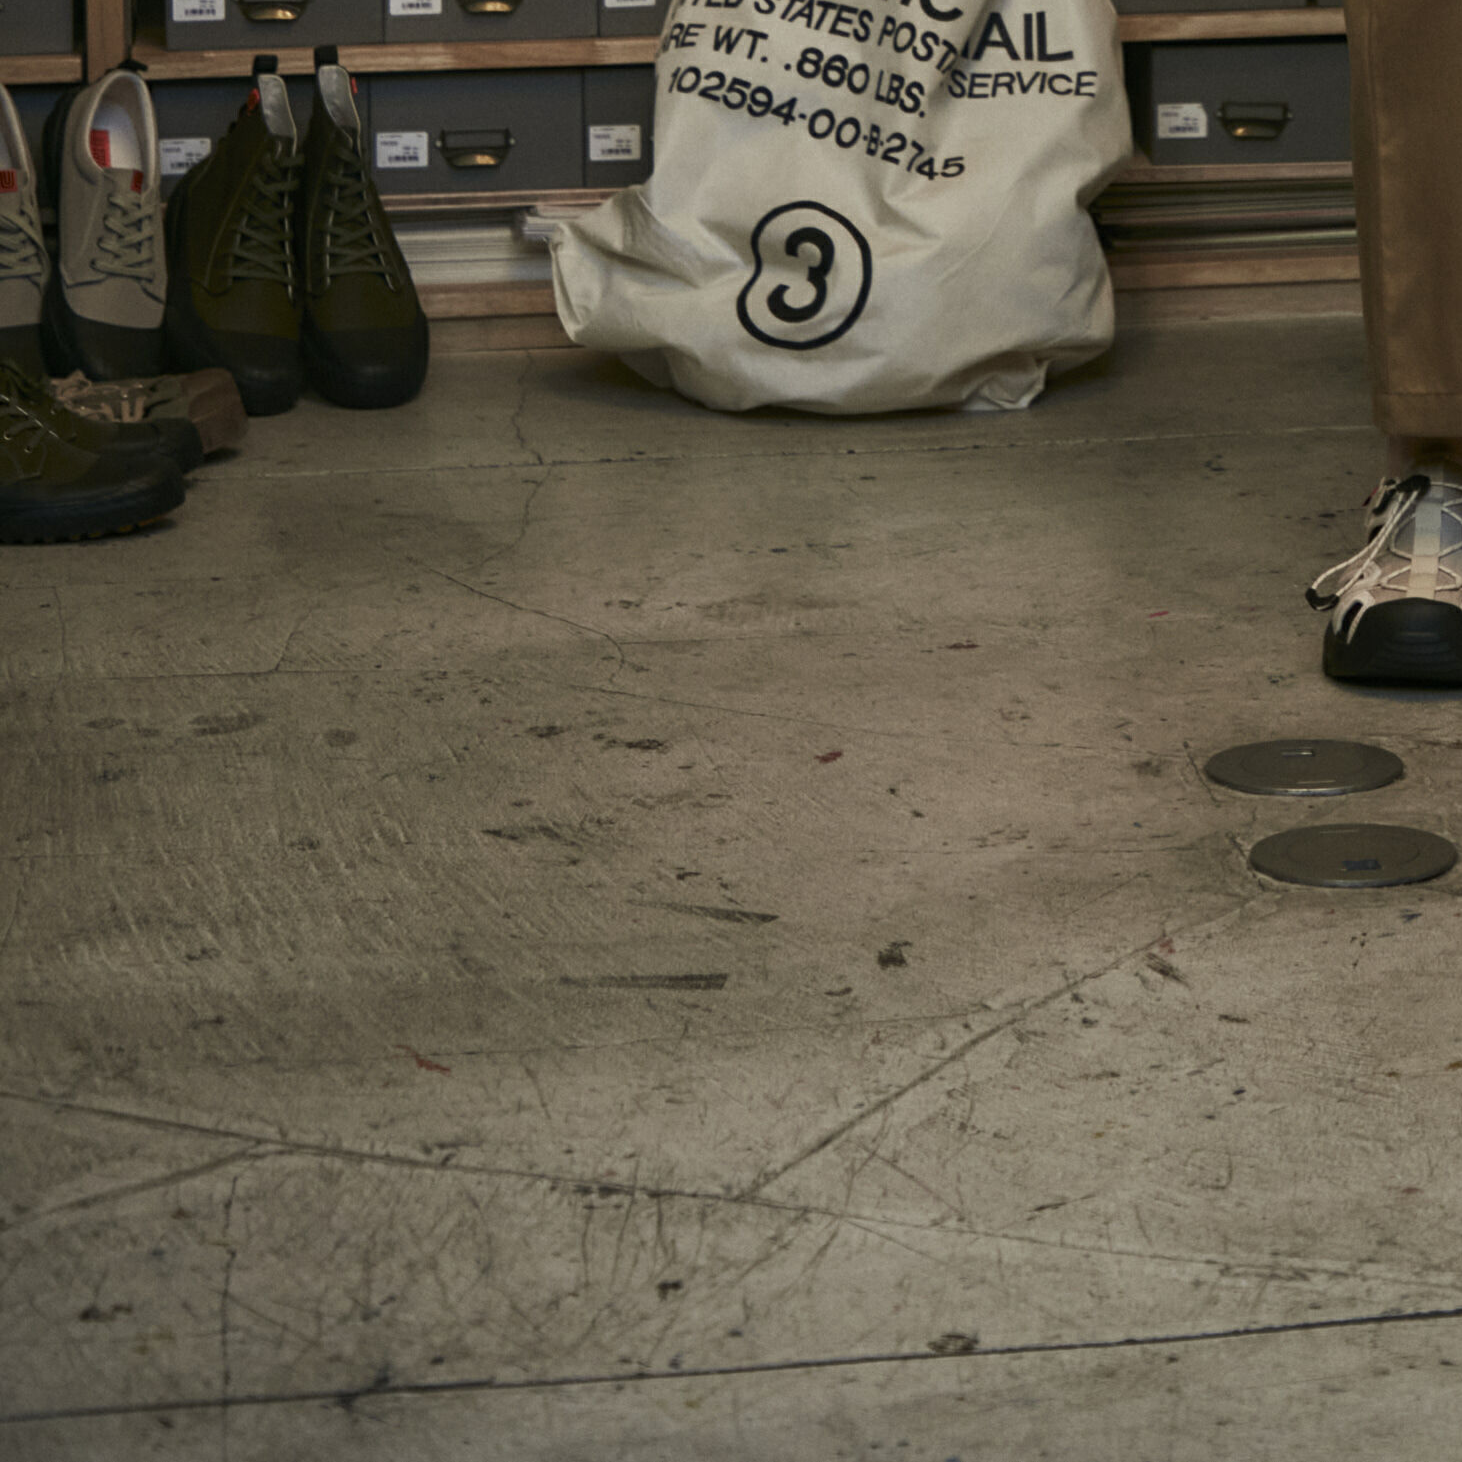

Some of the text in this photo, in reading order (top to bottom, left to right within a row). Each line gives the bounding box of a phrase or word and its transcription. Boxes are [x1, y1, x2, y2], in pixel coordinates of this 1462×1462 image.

[713, 25, 768, 63] WT.
[784, 47, 870, 94] .860
[874, 69, 926, 118] LBS.
[877, 15, 958, 74] POST
[948, 71, 1098, 98] SERVICE
[962, 11, 1074, 62] AIL
[766, 227, 835, 323] 3
